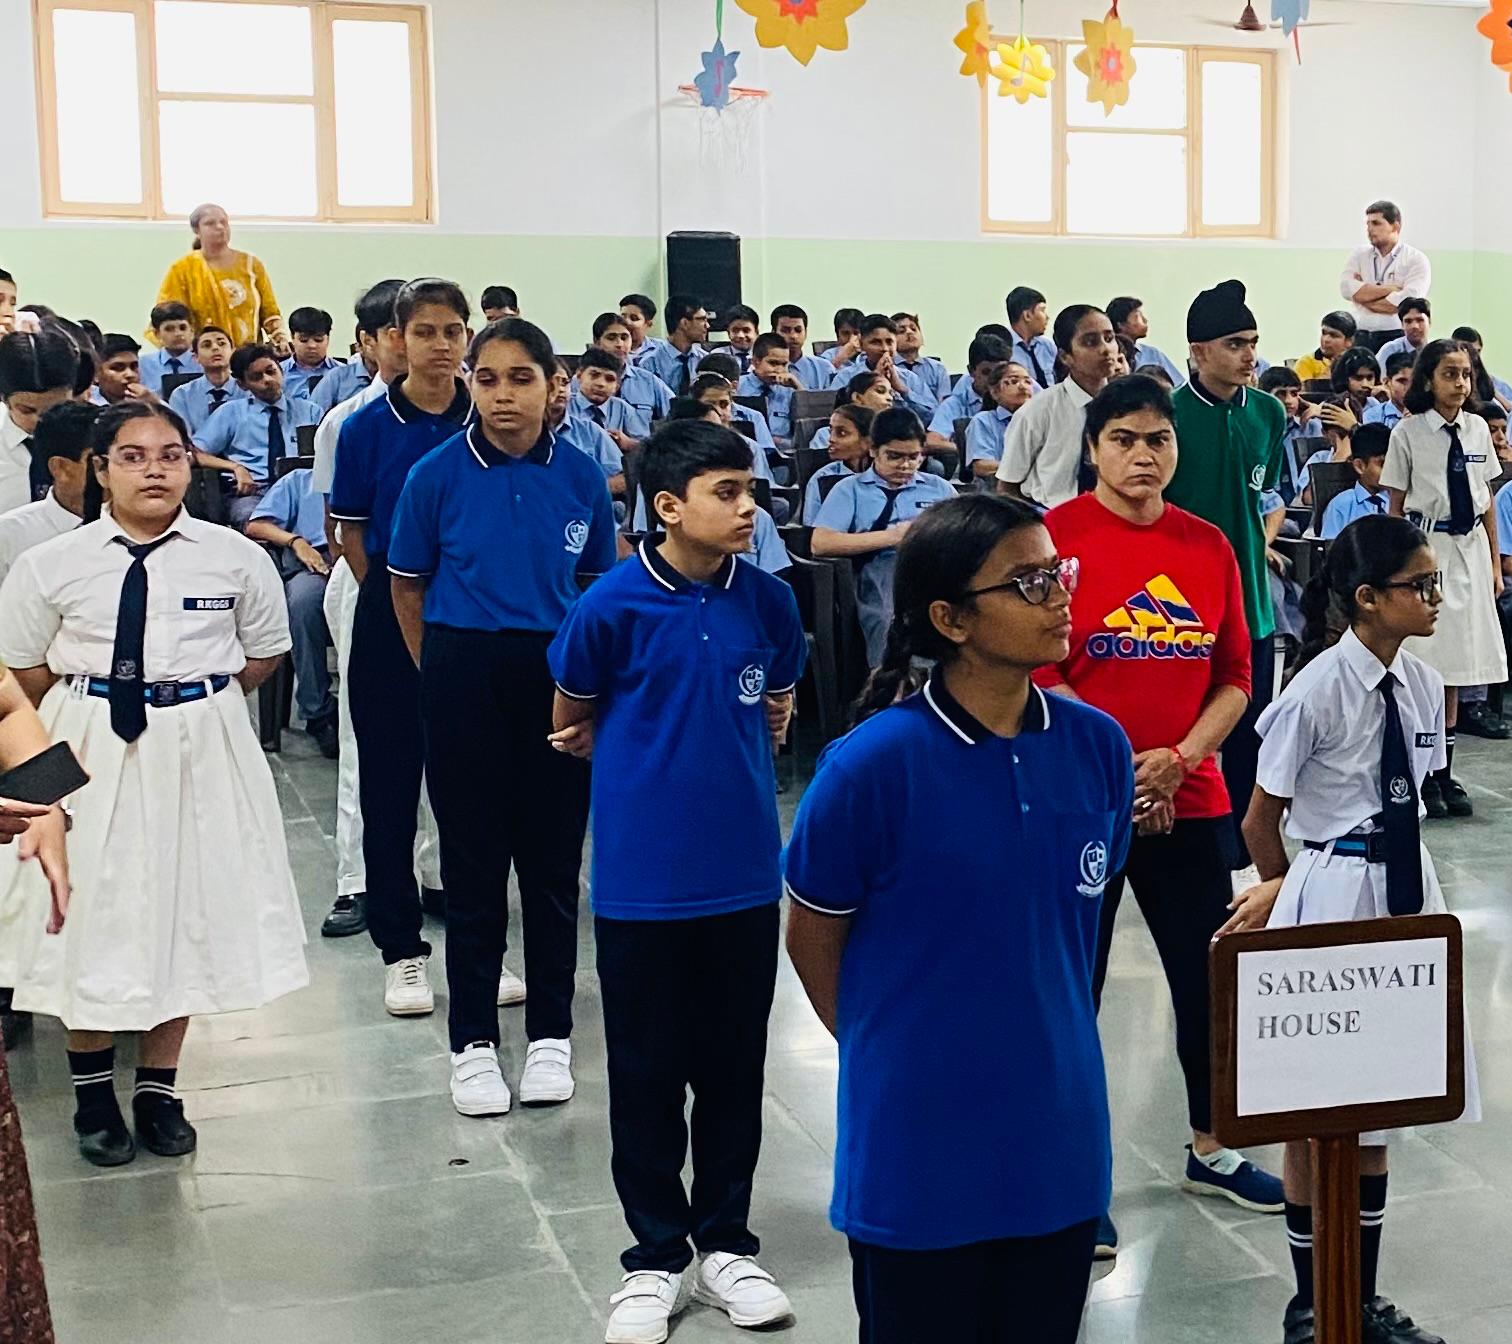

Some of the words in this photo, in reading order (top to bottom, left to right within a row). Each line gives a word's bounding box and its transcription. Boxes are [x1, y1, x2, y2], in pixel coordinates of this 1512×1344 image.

[1086, 624, 1216, 659] adidas
[1257, 963, 1436, 996] SARASWATI
[1258, 1010, 1361, 1039] HOUSE
